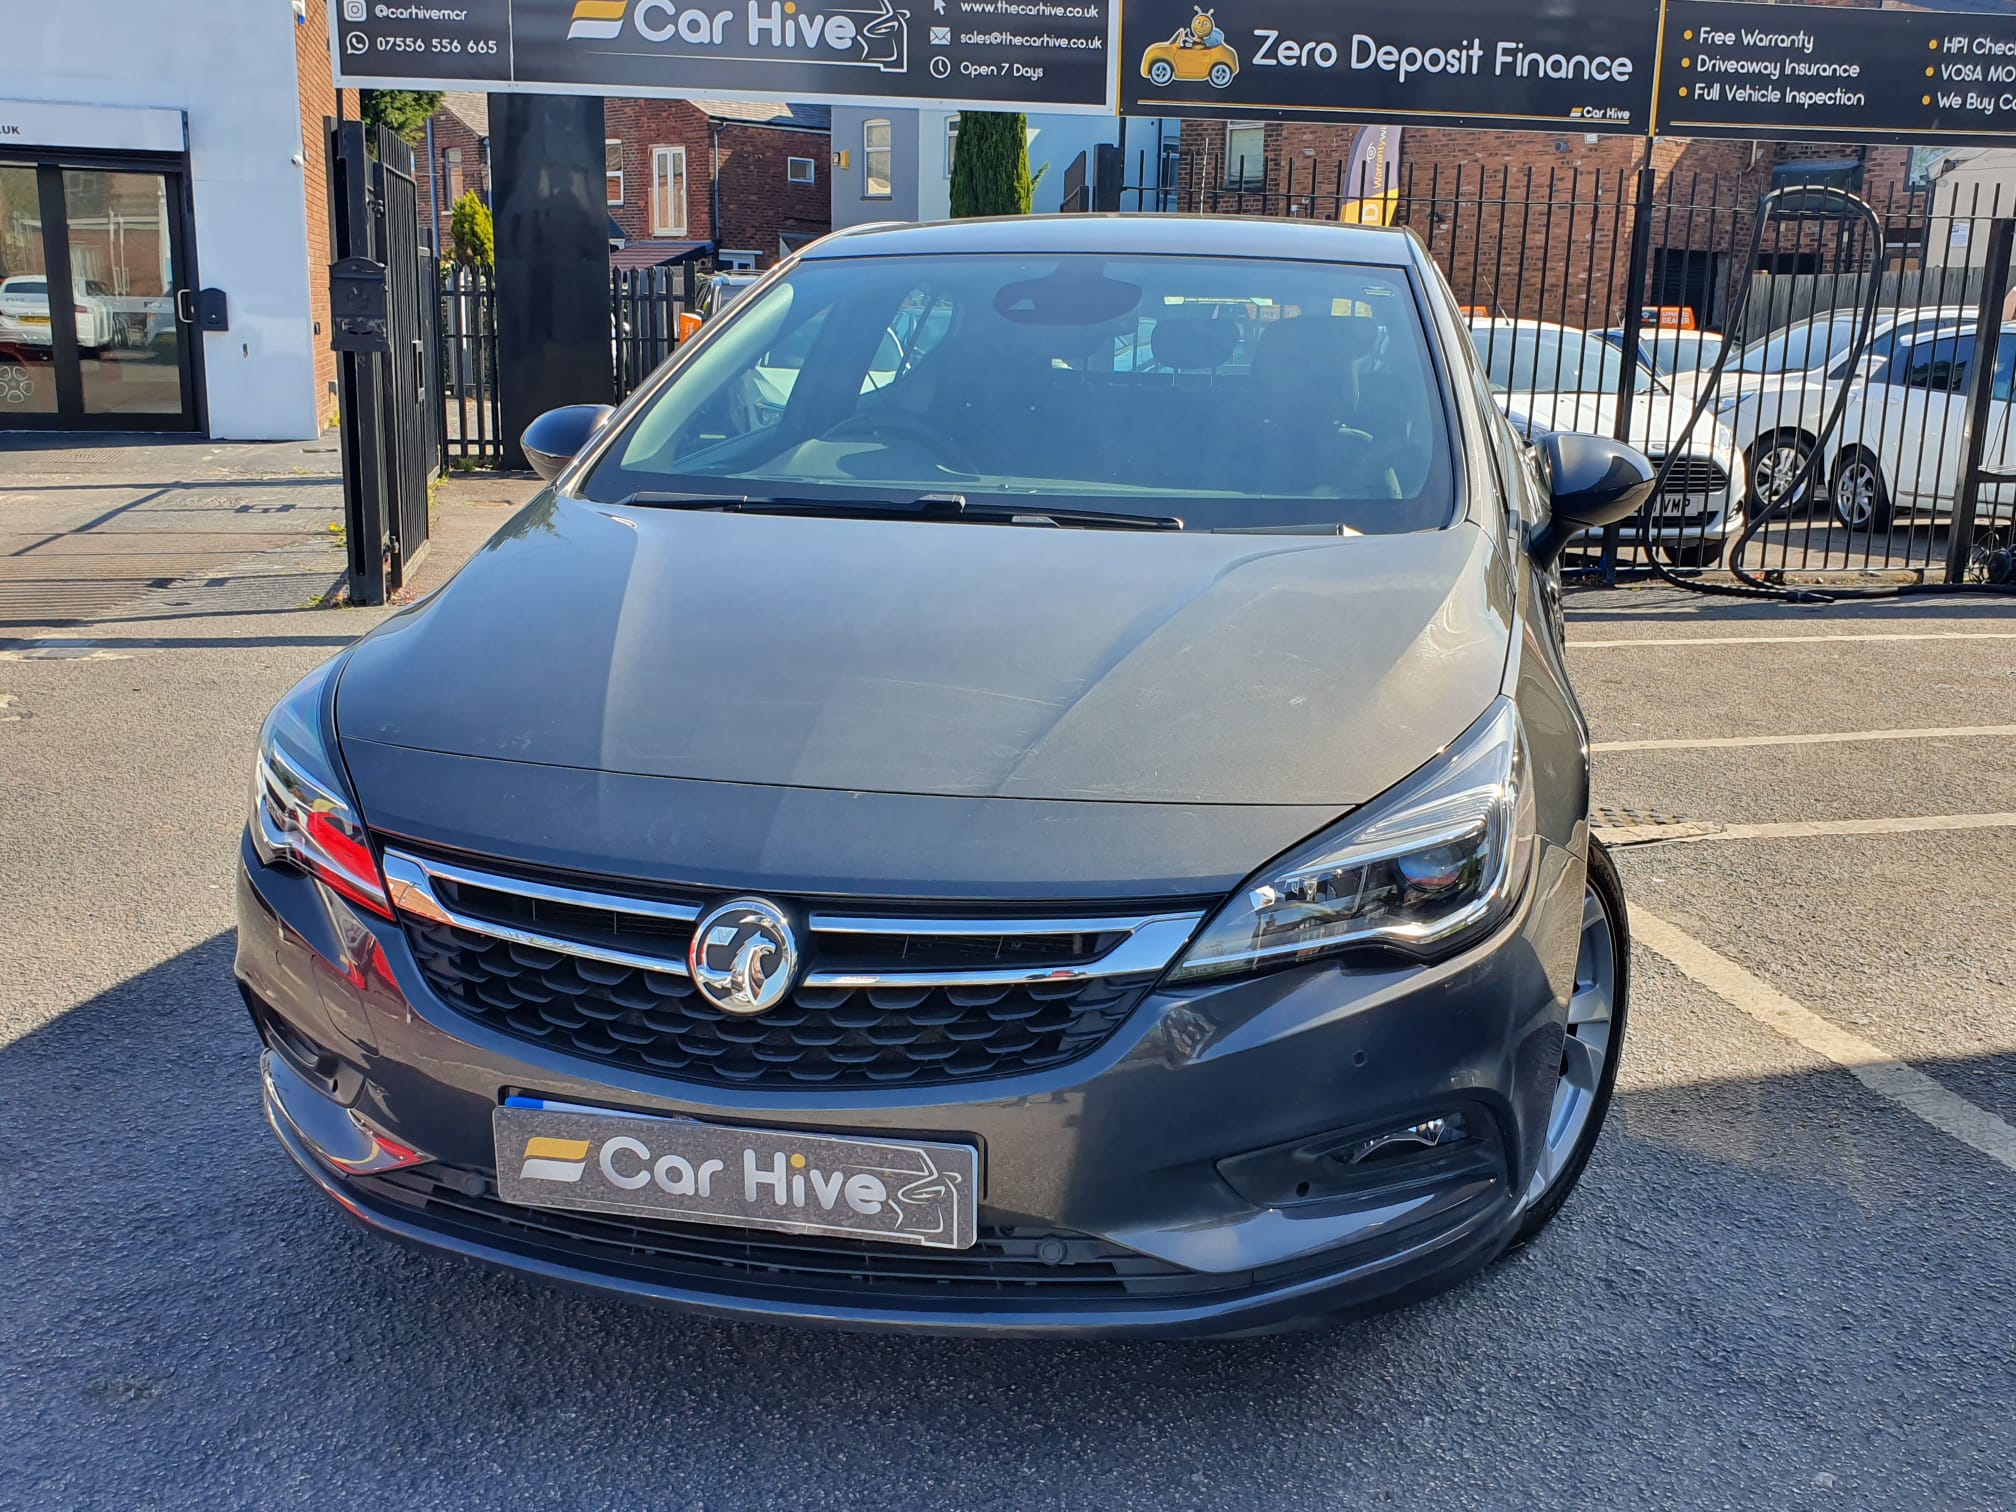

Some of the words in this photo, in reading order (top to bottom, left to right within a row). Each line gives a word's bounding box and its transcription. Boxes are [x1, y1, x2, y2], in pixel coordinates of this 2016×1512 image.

[375, 4, 468, 21] @carhivemcr
[960, 0, 1099, 18] www.thecarhive.co.uk
[633, 0, 734, 45] Car
[748, 1, 857, 50] Hive
[376, 37, 425, 52] 07556
[431, 38, 461, 53] 556
[467, 40, 497, 54] 665
[960, 30, 1102, 49] sales@thecarhive.co.uk
[1699, 27, 1736, 46] Free
[1741, 28, 1814, 53] Warranty
[1942, 36, 1969, 54] HPI
[1251, 29, 1338, 68] Zero
[1350, 34, 1484, 83] Deposit
[1494, 41, 1634, 82] Finance
[960, 61, 997, 79] Open
[1000, 63, 1010, 76] 7
[1013, 64, 1044, 81] Days
[1696, 54, 1780, 79] Driveaway
[1784, 58, 1860, 78] Insurance
[1941, 63, 1983, 81] VOSA
[1694, 83, 1720, 101] Full
[1725, 84, 1781, 103] Vehicle
[1785, 86, 1865, 109] Inspection
[1937, 91, 1962, 109] We
[1966, 92, 1995, 115] Buy
[1583, 106, 1605, 118] Car
[1606, 107, 1630, 120] Hive
[599, 1136, 724, 1198] Car
[743, 1148, 887, 1216] Hive
